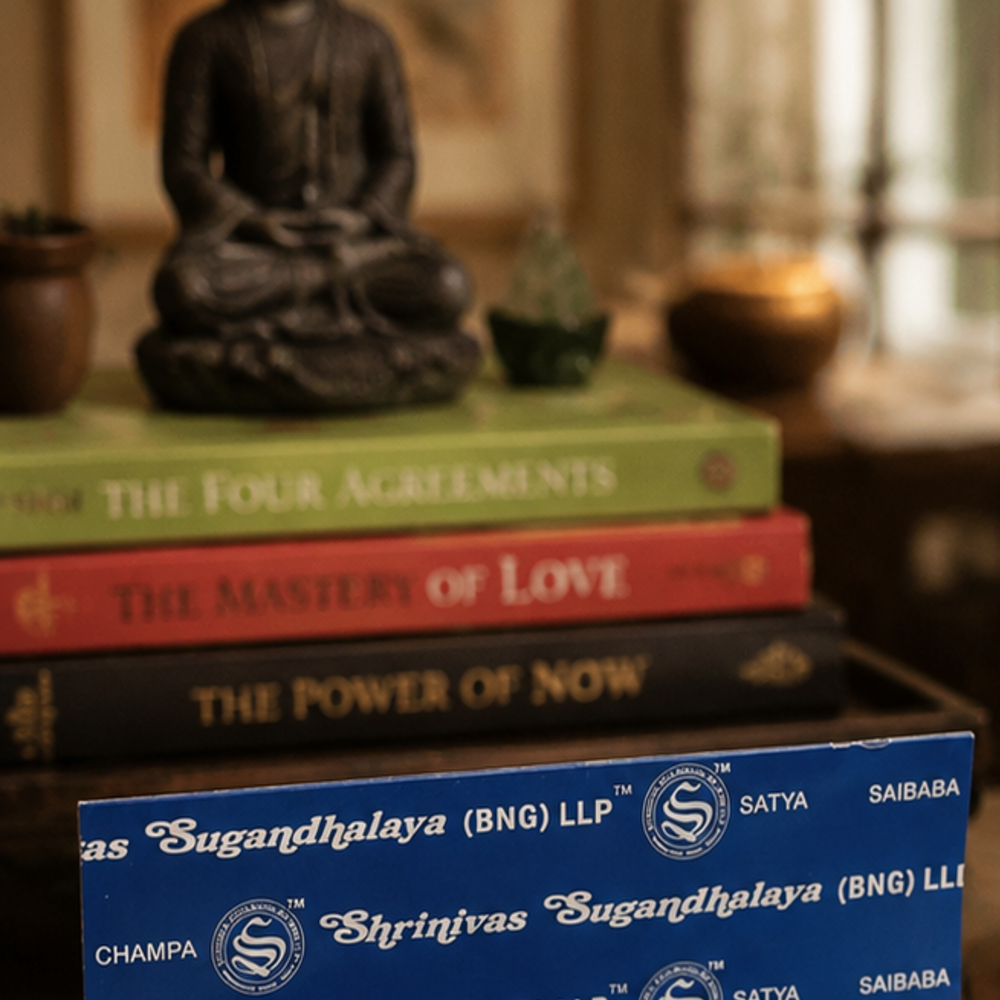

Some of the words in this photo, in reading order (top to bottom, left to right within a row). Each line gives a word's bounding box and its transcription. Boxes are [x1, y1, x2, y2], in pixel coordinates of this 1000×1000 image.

[101, 476, 192, 520] THE
[202, 466, 326, 516] FOUR
[335, 455, 618, 510] AGREEMENTS
[109, 580, 201, 626] THE
[426, 566, 489, 608] OF
[499, 553, 631, 606] LOVE
[193, 682, 281, 727] THE
[293, 669, 450, 720] POWER
[460, 665, 523, 710] OF
[530, 654, 650, 707] NOW
[740, 791, 808, 814] SATYA
[870, 779, 960, 803] SAIBABA
[145, 811, 446, 858] Sugandhalaya
[464, 803, 548, 837] (BNG)
[561, 799, 612, 826] LLP
[320, 909, 527, 949] Shrinivas
[544, 882, 822, 927] Sugandhalaya
[838, 869, 914, 904] (BNG)
[96, 940, 197, 965] CHAMPA
[860, 968, 950, 994] SAIBABA
